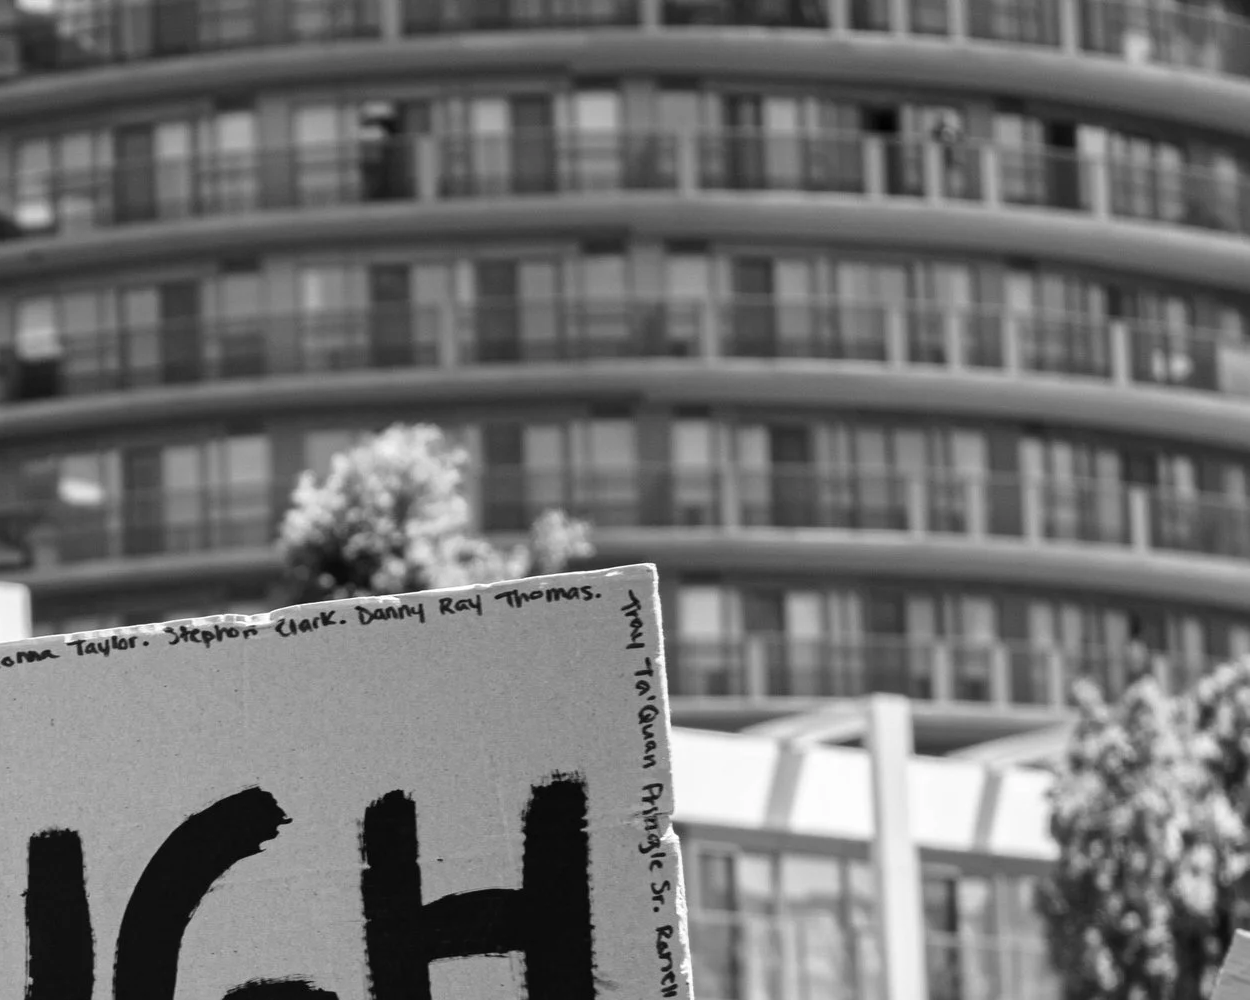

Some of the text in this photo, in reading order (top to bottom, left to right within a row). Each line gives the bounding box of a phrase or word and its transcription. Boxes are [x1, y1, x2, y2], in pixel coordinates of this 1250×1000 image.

[66, 635, 150, 657] Taylor.
[164, 625, 258, 649] Stephon
[275, 610, 347, 637] Clark.
[355, 602, 426, 625] Danny
[439, 594, 484, 616] Ray
[495, 584, 602, 608] Thomas.
[633, 656, 660, 769] Ta'Quan
[650, 879, 672, 914] Sr.
